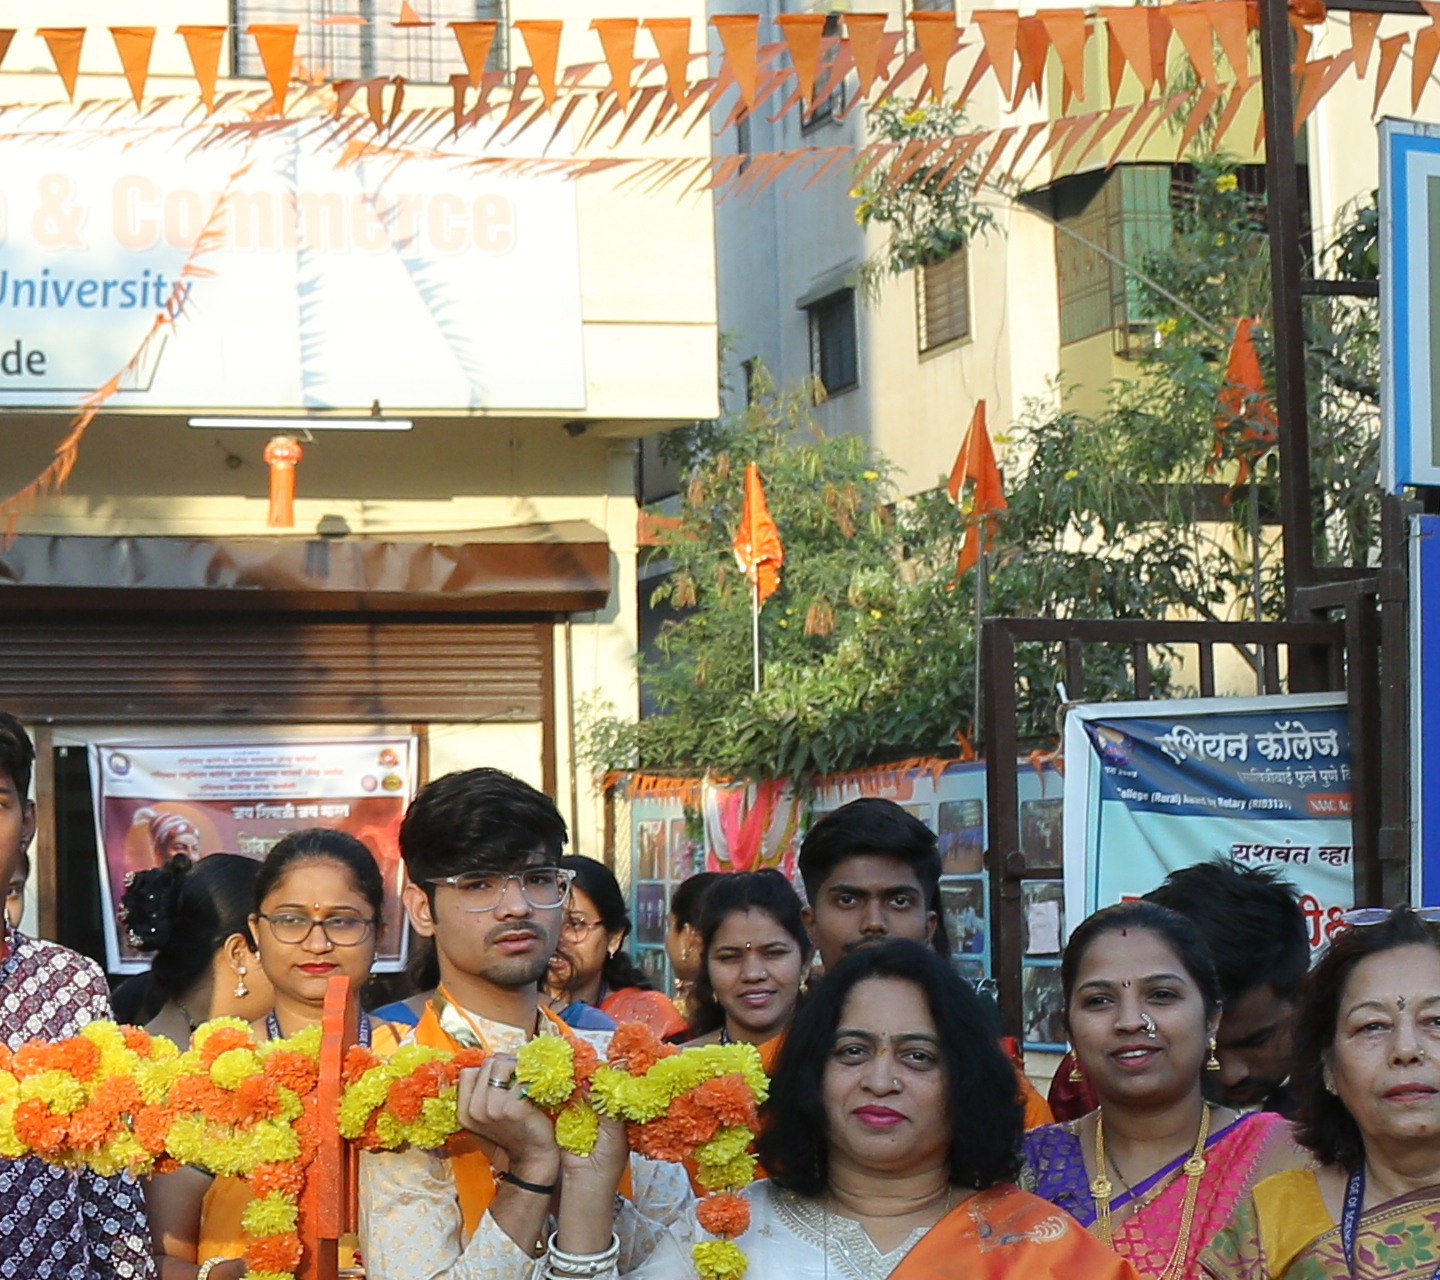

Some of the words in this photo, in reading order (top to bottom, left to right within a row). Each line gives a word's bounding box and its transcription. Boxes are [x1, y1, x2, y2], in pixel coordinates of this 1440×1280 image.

[29, 173, 92, 251] &
[110, 173, 514, 254] Commerce
[1255, 720, 1341, 762] कॉलेज
